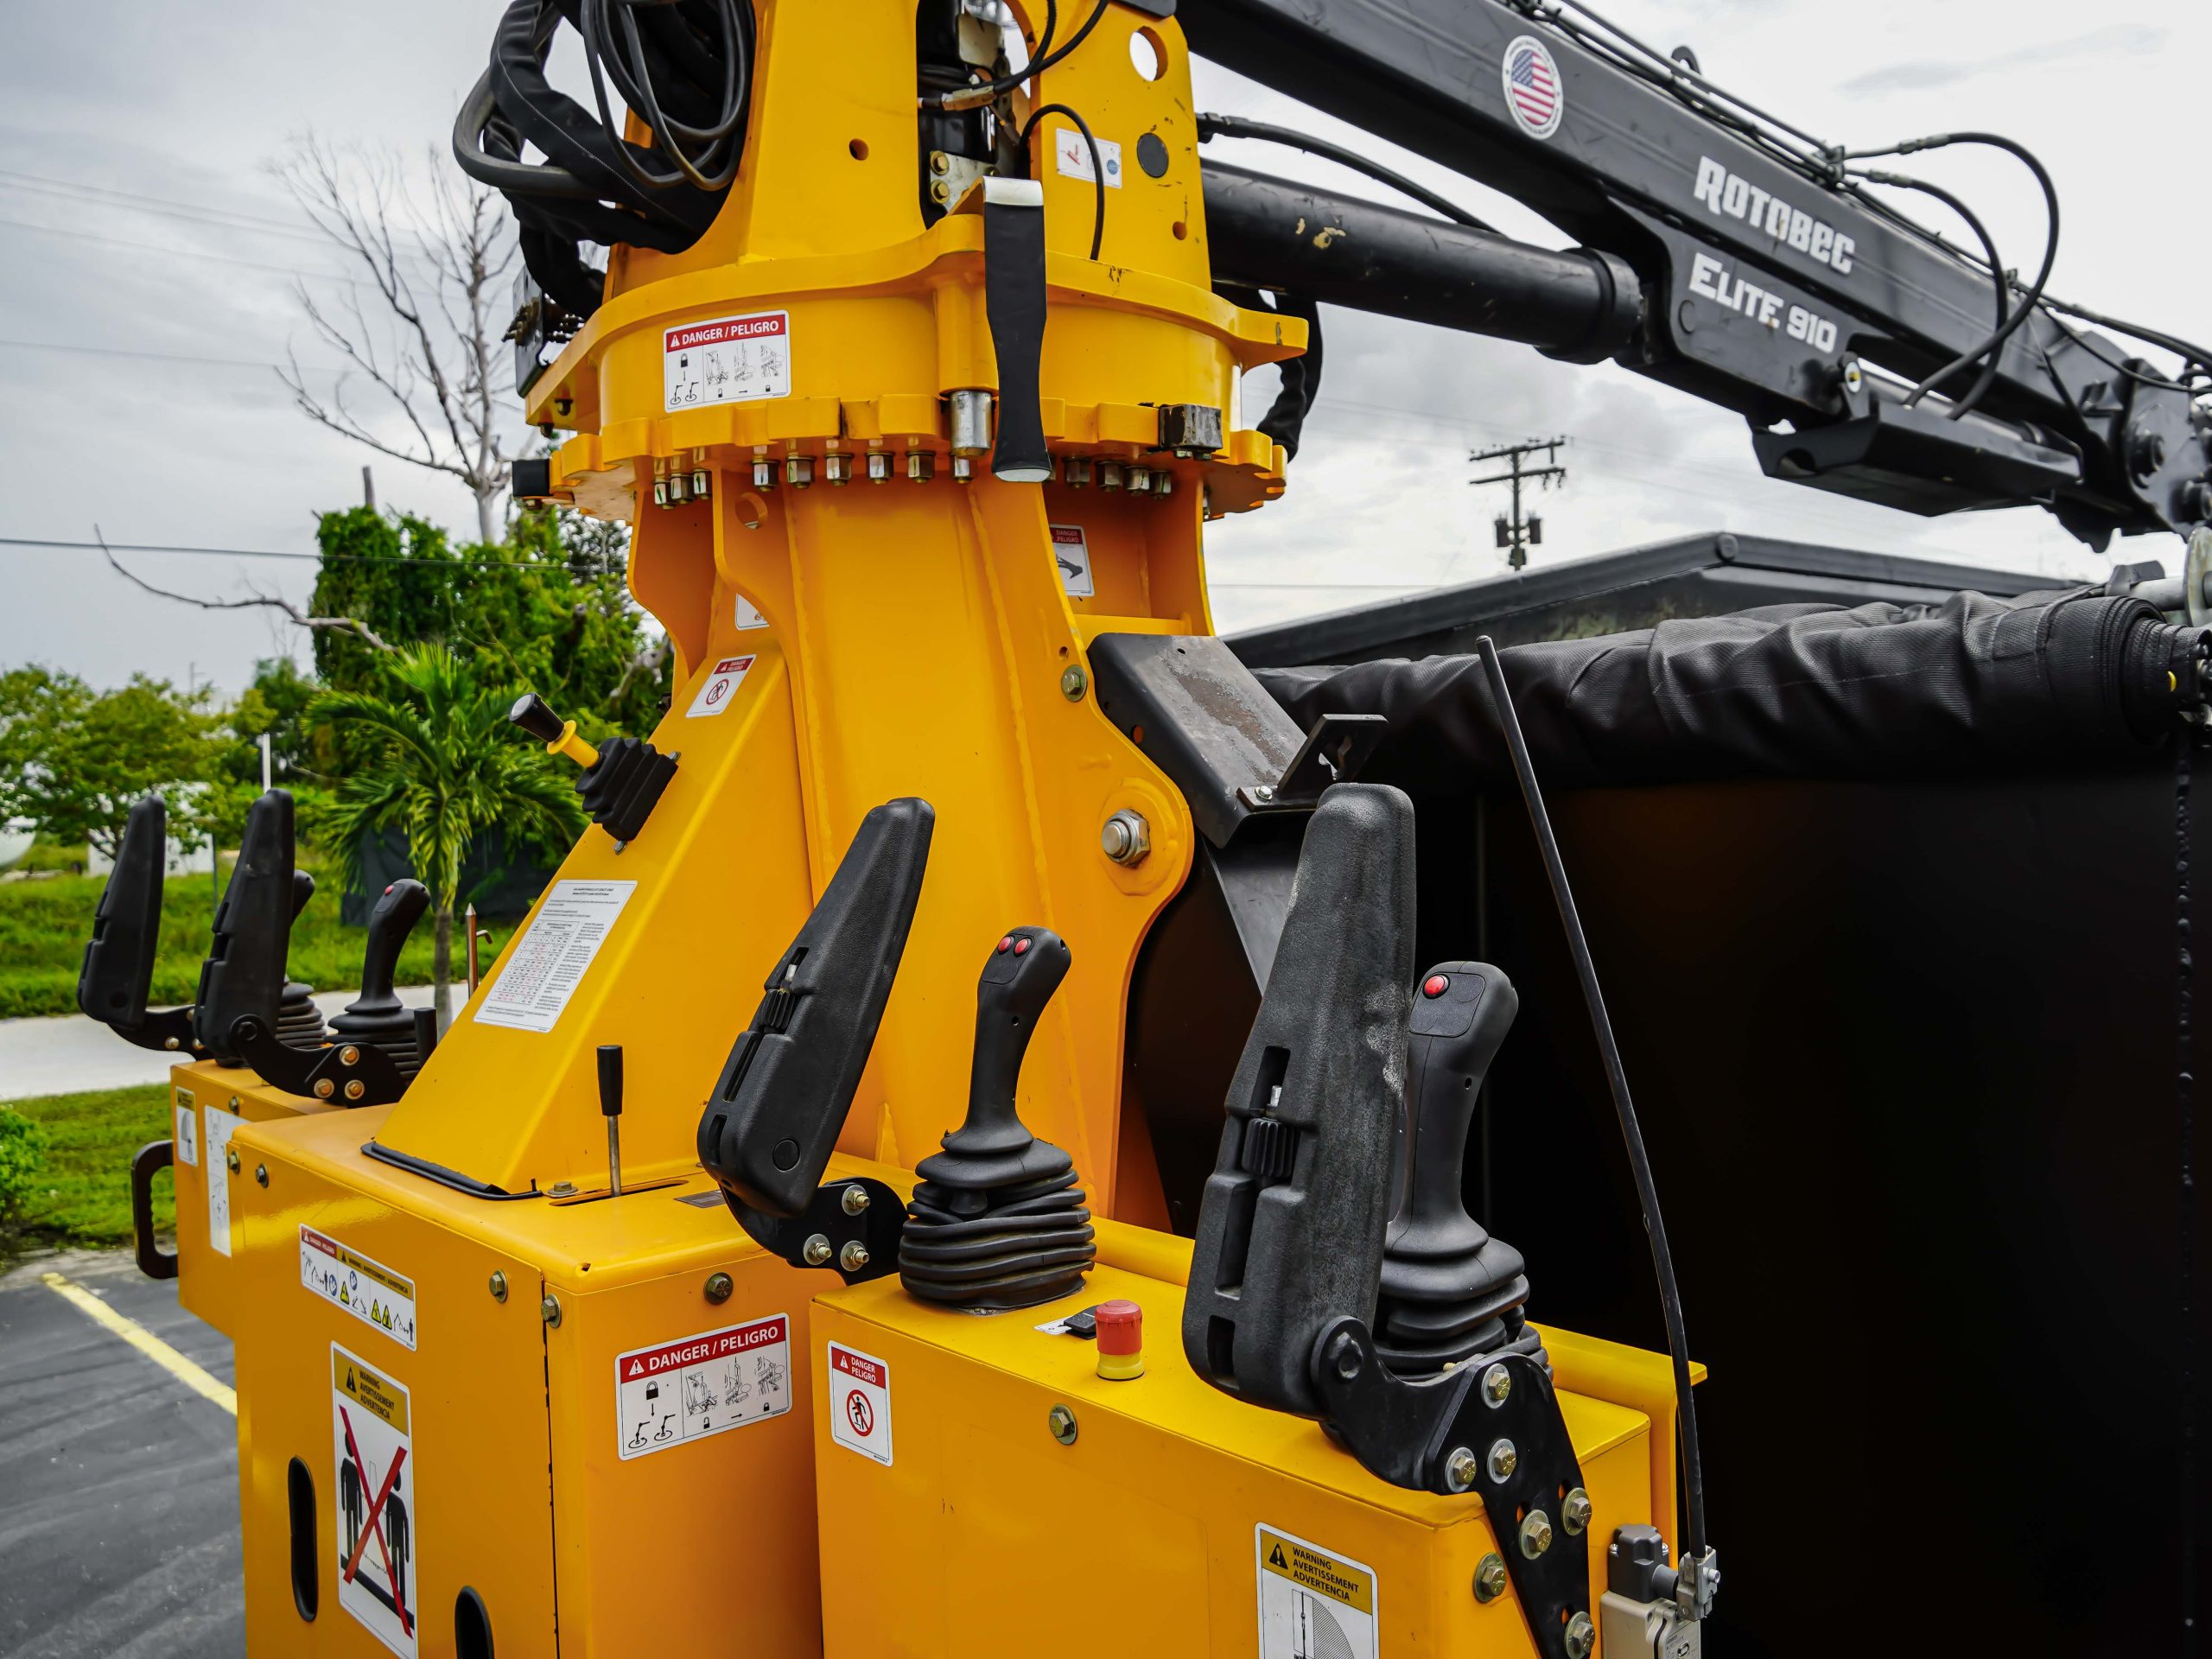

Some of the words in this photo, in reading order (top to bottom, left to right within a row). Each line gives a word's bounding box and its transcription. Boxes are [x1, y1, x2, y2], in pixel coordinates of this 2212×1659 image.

[1688, 252, 1783, 328] ELITE
[1787, 305, 1837, 353] 910
[682, 328, 722, 345] DANGER
[731, 320, 779, 336] PELIGRO
[649, 1344, 709, 1370] DANGER
[721, 1325, 779, 1351] PELIGRO
[851, 1357, 875, 1373] DANGER
[851, 1366, 876, 1382] PELIGRO
[359, 1370, 380, 1389] WARNING
[359, 1382, 395, 1411] AVERTISSEMENT
[359, 1394, 391, 1420] ADVERTENCIA
[1293, 1547, 1332, 1570] WARNING
[1293, 1559, 1359, 1593] AVERTISSEMENT
[1294, 1570, 1350, 1601] ADVERTENCIA
